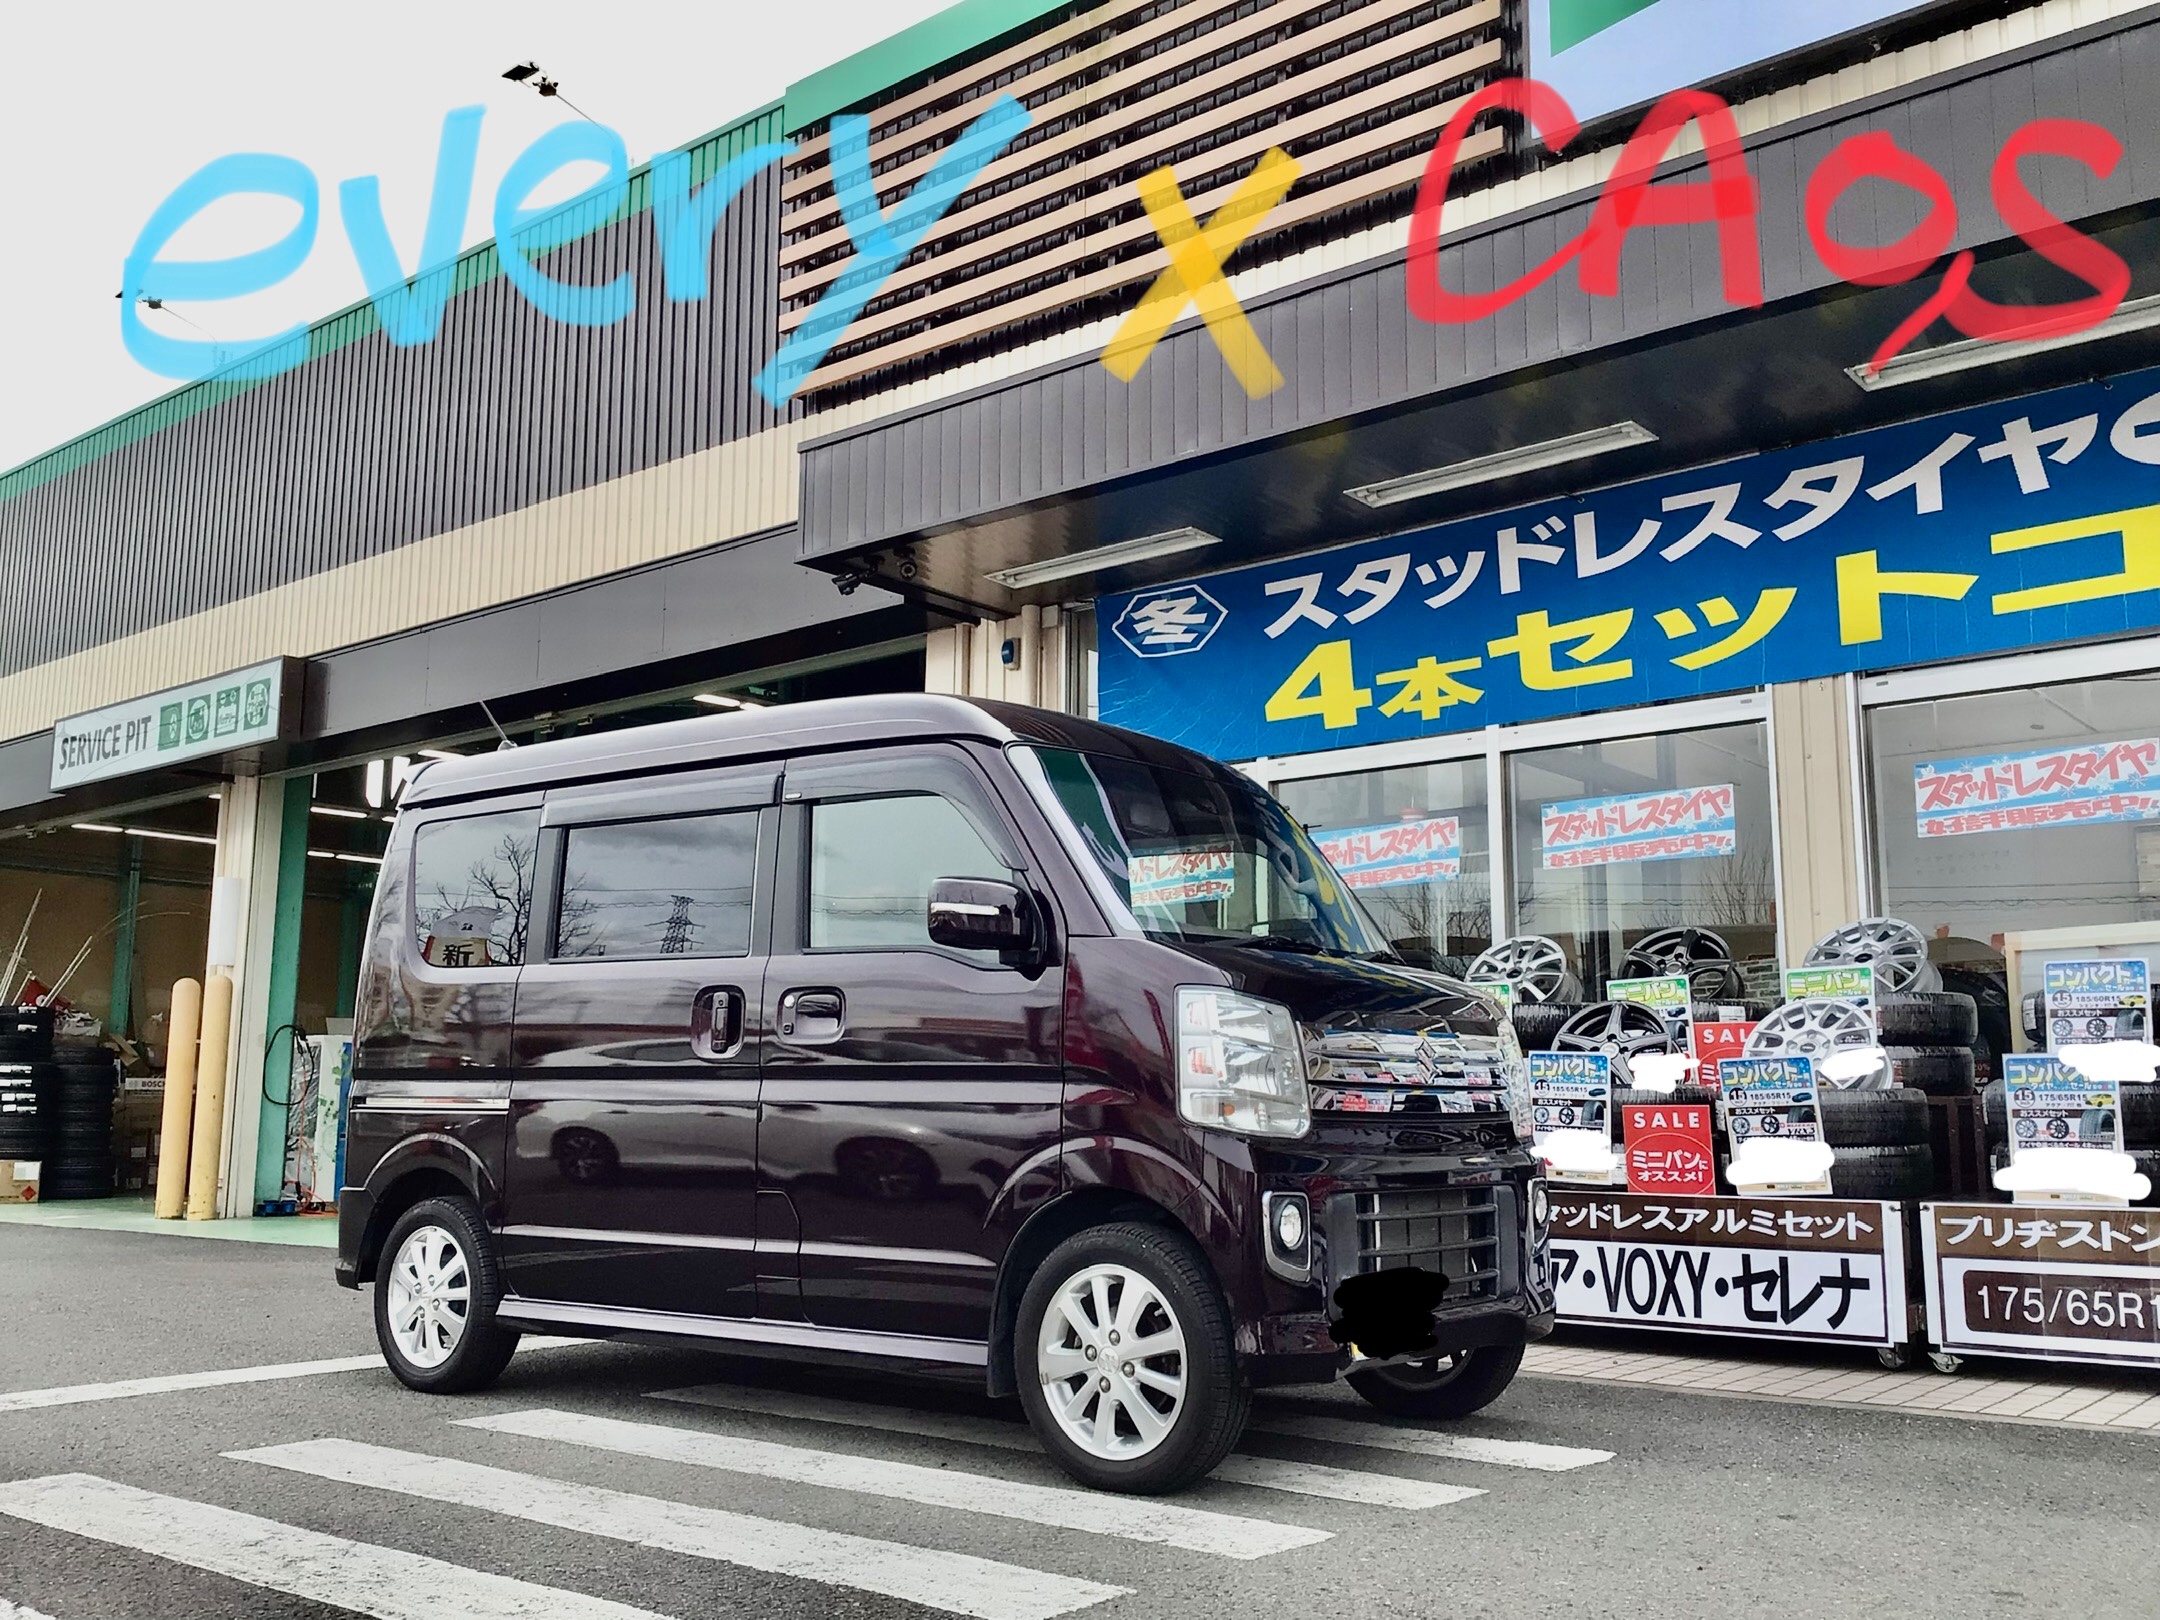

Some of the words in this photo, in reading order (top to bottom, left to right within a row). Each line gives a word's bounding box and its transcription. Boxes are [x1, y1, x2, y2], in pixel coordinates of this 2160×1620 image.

[1132, 596, 1208, 645] 冬
[59, 724, 121, 770] SERVICE
[125, 715, 151, 754] PIT
[1918, 743, 2156, 811] スタッドレスタイヤ
[1544, 788, 1731, 846] スタッドレスタイヤ
[2054, 992, 2071, 1002] 15
[2057, 1009, 2103, 1017] おススメセット
[2015, 1090, 2033, 1101] 15
[2039, 1093, 2088, 1102] 175/65R15
[1735, 1107, 1776, 1115] おススメセット
[2020, 1109, 2069, 1118] おススメセット
[1633, 1112, 1700, 1129] SALE
[1632, 1149, 1709, 1170] ミニバンに
[1637, 1170, 1704, 1182] オススメ!
